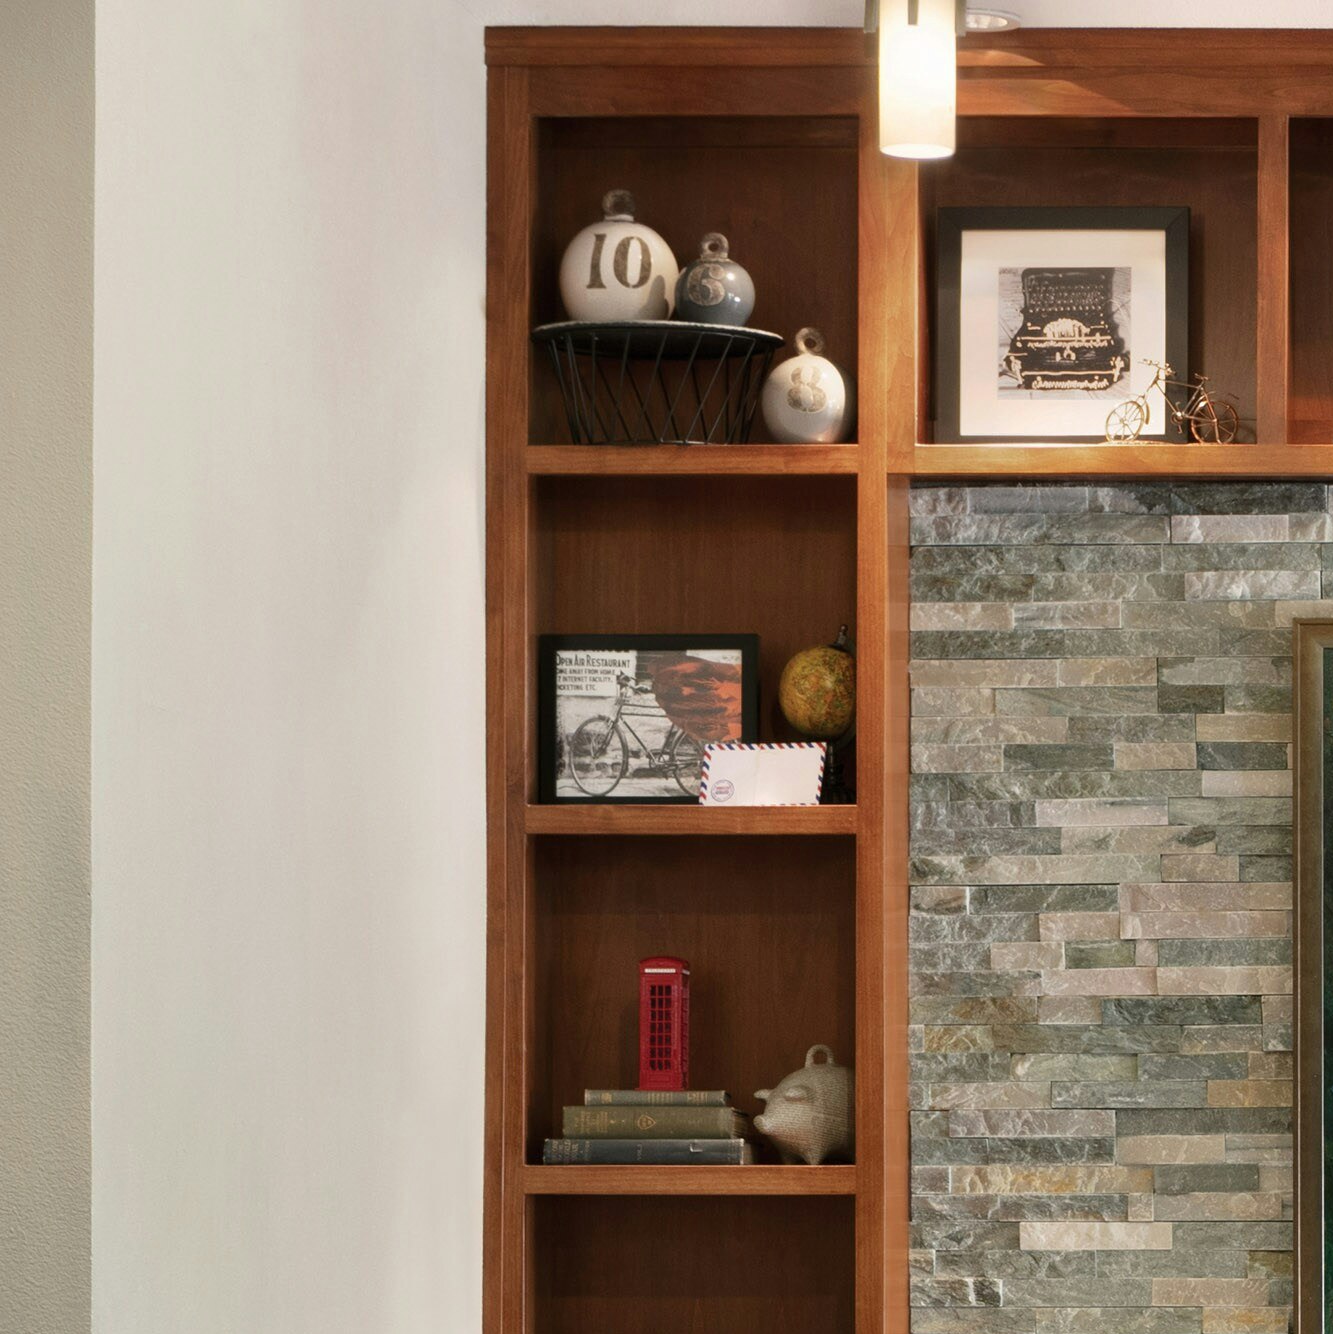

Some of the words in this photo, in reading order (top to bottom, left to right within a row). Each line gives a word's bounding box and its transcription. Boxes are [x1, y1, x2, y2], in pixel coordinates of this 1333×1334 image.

[586, 233, 652, 289] 10
[687, 263, 726, 306] 6
[787, 367, 826, 412] 8
[585, 668, 599, 676] FROM
